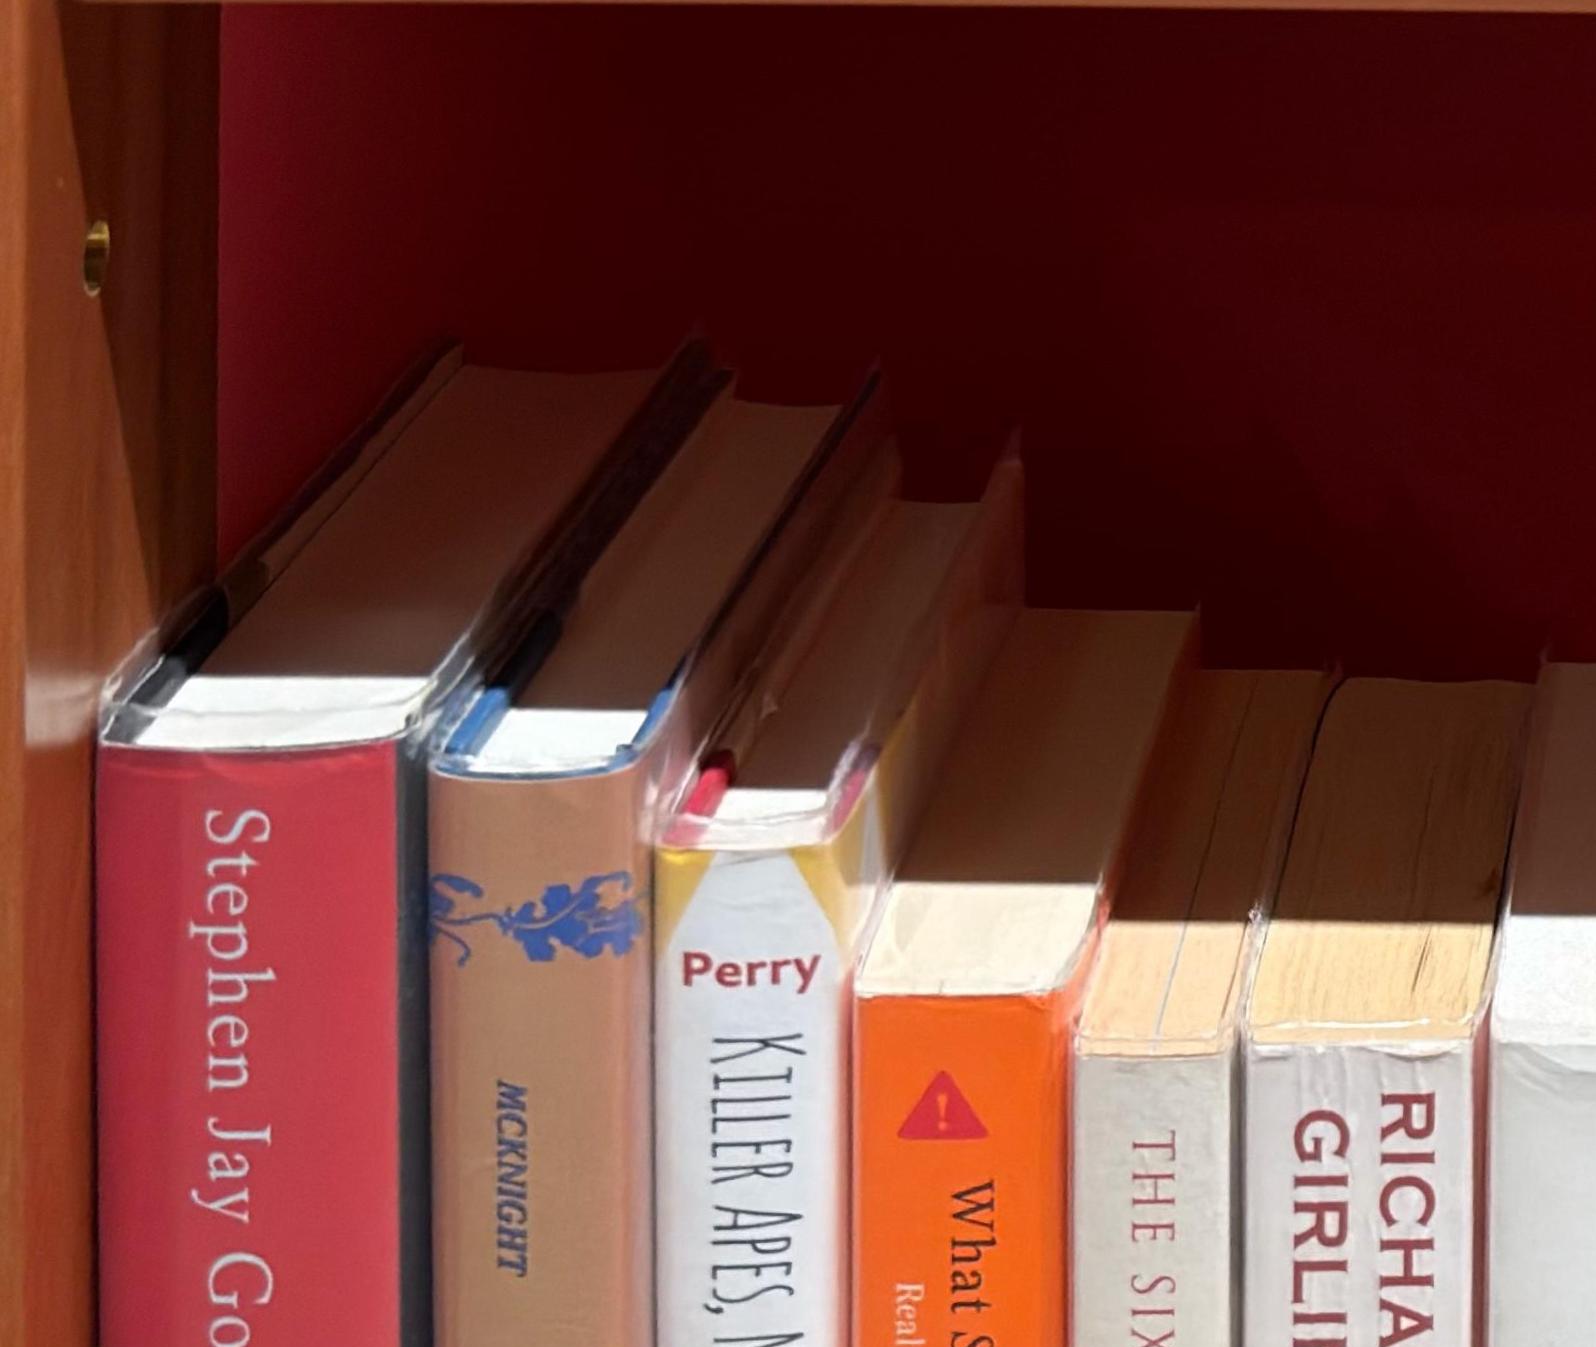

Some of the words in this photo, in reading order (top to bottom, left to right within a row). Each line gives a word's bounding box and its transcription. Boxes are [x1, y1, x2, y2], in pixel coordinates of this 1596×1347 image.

[189, 809, 275, 1092] Stephen
[683, 952, 819, 993] Perry
[708, 1032, 806, 1184] KILLER
[190, 1117, 272, 1222] Jay
[495, 1080, 529, 1277] MCKNIGHT
[1132, 1130, 1176, 1244] THE
[702, 1204, 804, 1315] APES,
[949, 1179, 998, 1312] What
[894, 1282, 925, 1341] Real
